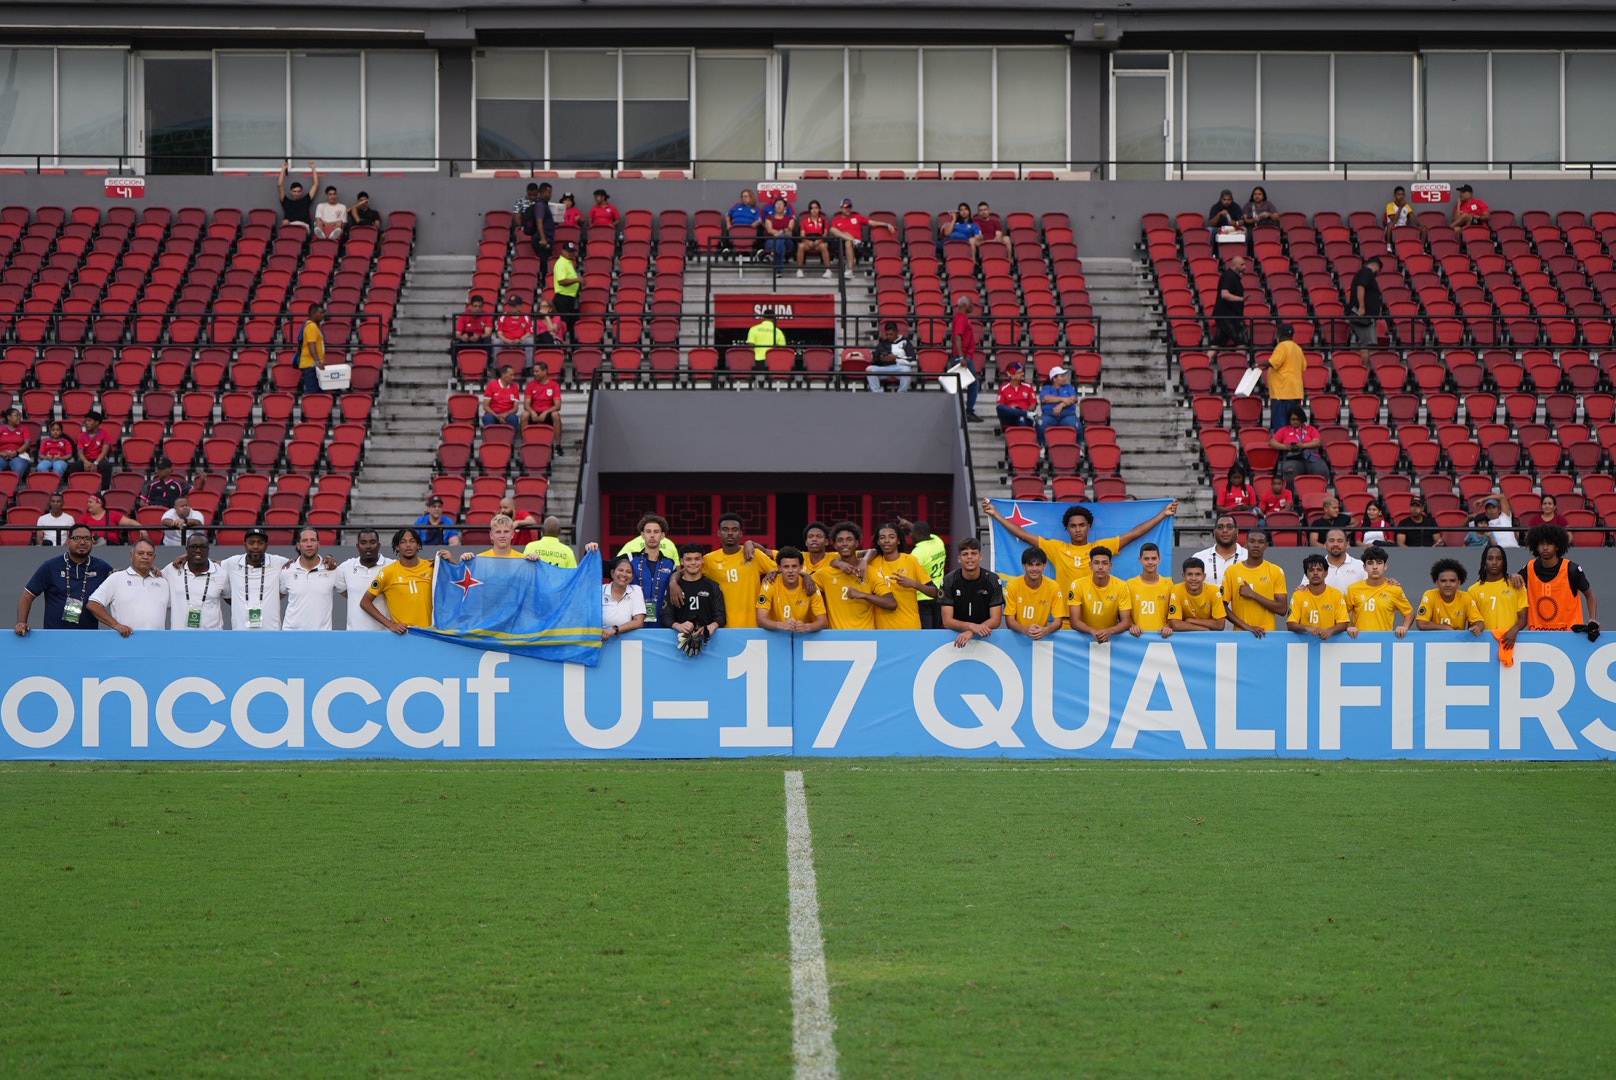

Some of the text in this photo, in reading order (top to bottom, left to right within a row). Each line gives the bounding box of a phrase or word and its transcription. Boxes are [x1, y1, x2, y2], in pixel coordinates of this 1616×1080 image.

[117, 187, 132, 198] 41
[1420, 191, 1442, 202] 43
[754, 304, 793, 319] SAIDA
[535, 550, 567, 560] SEGURIDAD
[726, 568, 739, 583] 19
[408, 580, 419, 595] 11
[841, 586, 849, 600] 2
[1541, 583, 1552, 597] 18
[689, 596, 700, 610] 21
[968, 602, 972, 616] 1
[1093, 601, 1104, 615] 17
[1141, 600, 1155, 615] 20
[1364, 598, 1376, 612] 16
[1490, 596, 1497, 610] 7
[783, 604, 791, 619] 8
[1022, 606, 1035, 619] 10
[1309, 610, 1319, 624] 15
[563, 639, 878, 750] U-17
